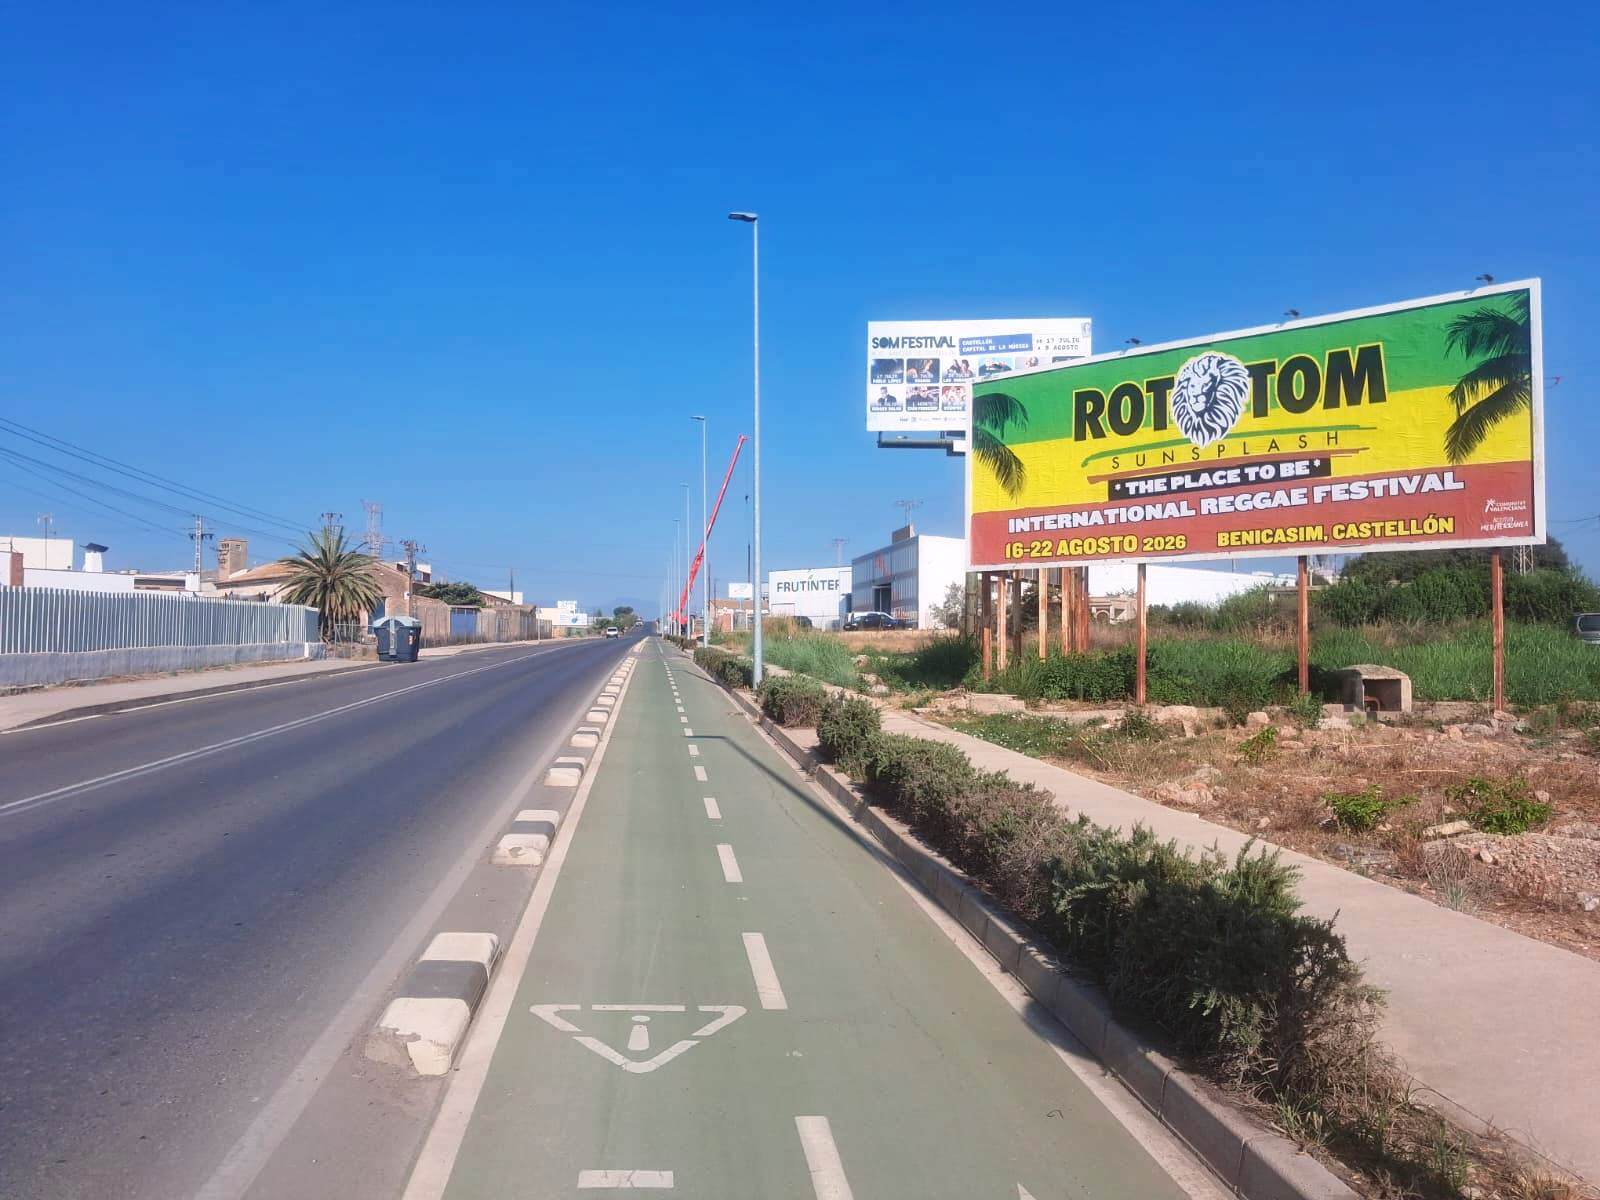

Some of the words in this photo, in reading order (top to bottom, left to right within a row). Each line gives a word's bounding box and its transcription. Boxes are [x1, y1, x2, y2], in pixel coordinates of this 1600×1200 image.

[872, 336, 899, 349] SOM
[902, 335, 956, 348] FESTIVAL
[1111, 431, 1339, 470] SUNSPLASH
[1125, 478, 1168, 495] THE
[1171, 469, 1241, 490] PLACE
[1244, 464, 1276, 482] TO
[1280, 460, 1310, 478] BE
[1008, 500, 1196, 534] INTERNATIONAL
[1200, 487, 1309, 515] REGGAE
[1313, 471, 1466, 504] FESTIVAL
[1005, 540, 1053, 559] 16-22
[1056, 535, 1138, 556] AGOSTO
[1142, 535, 1187, 552] 2026
[1217, 523, 1329, 548] BENICASIM,
[1333, 515, 1455, 540] CASTELLÓN
